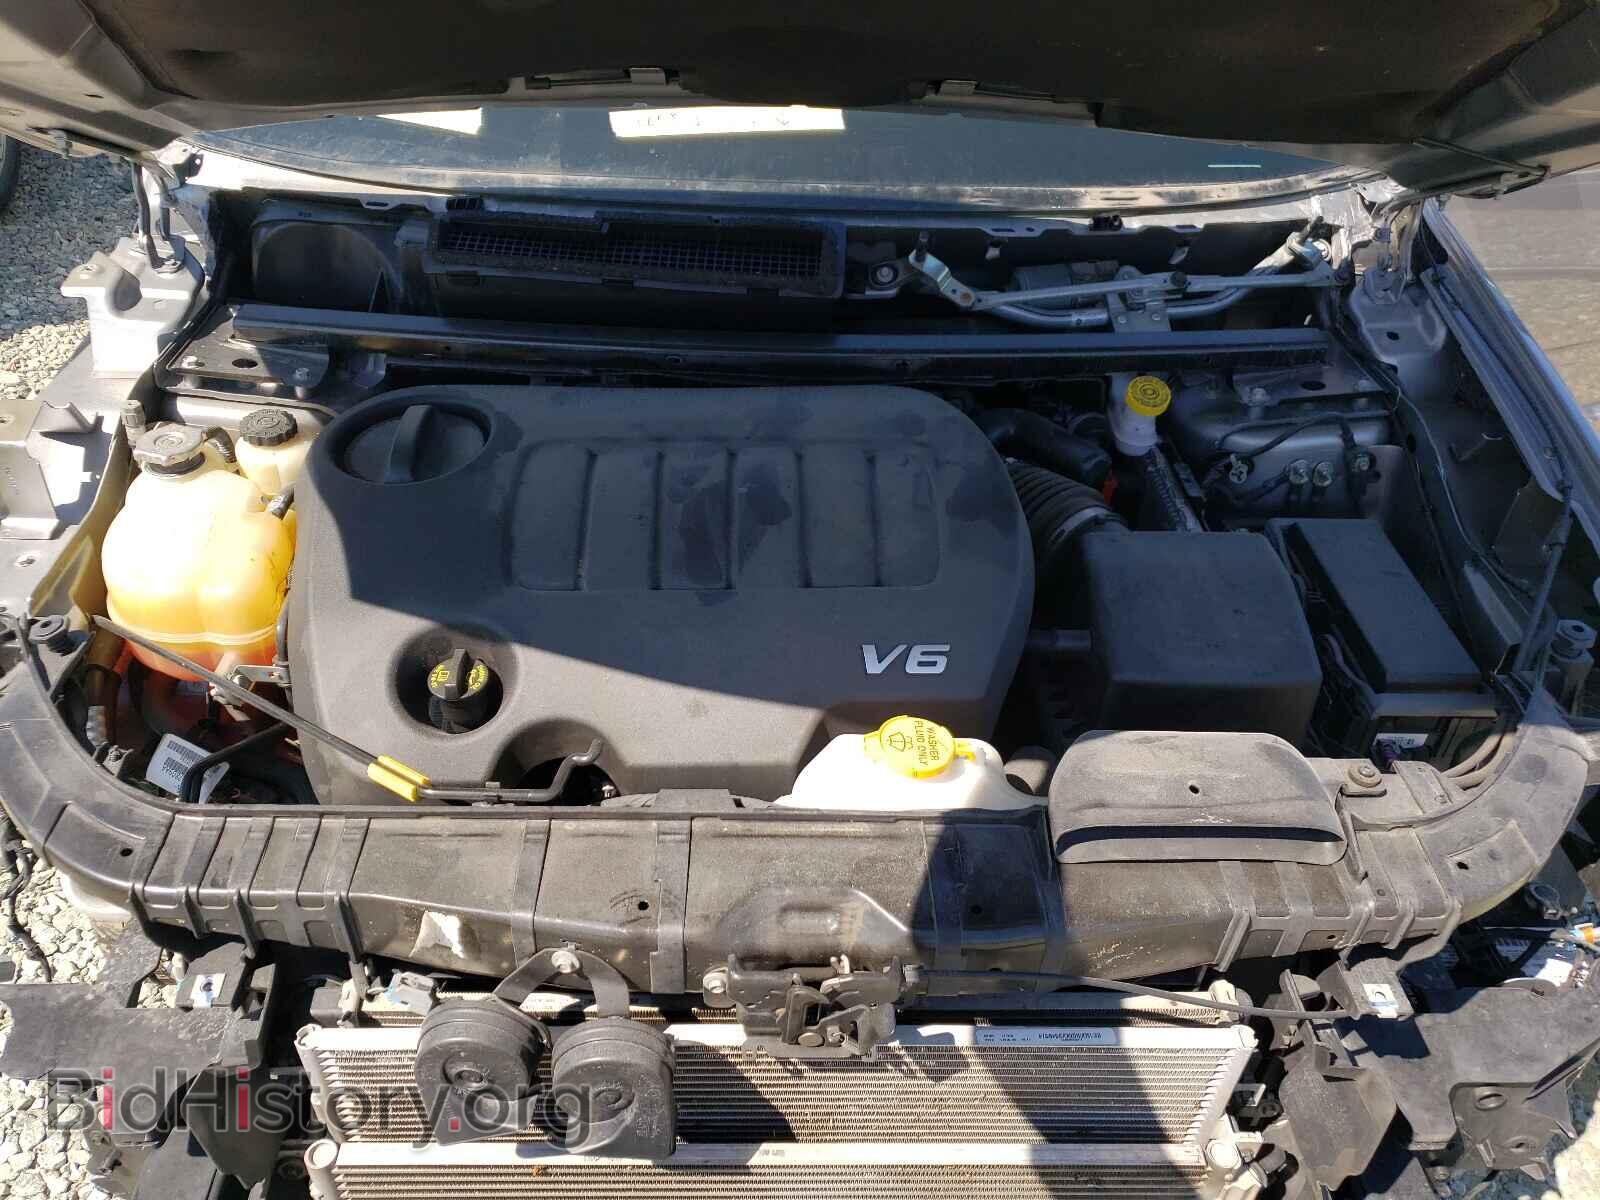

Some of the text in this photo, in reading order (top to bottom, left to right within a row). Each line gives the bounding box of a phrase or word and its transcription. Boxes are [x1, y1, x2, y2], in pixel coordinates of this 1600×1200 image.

[862, 644, 950, 674] V6
[914, 721, 928, 766] FLUID ONLY
[926, 727, 940, 761] WASHER
